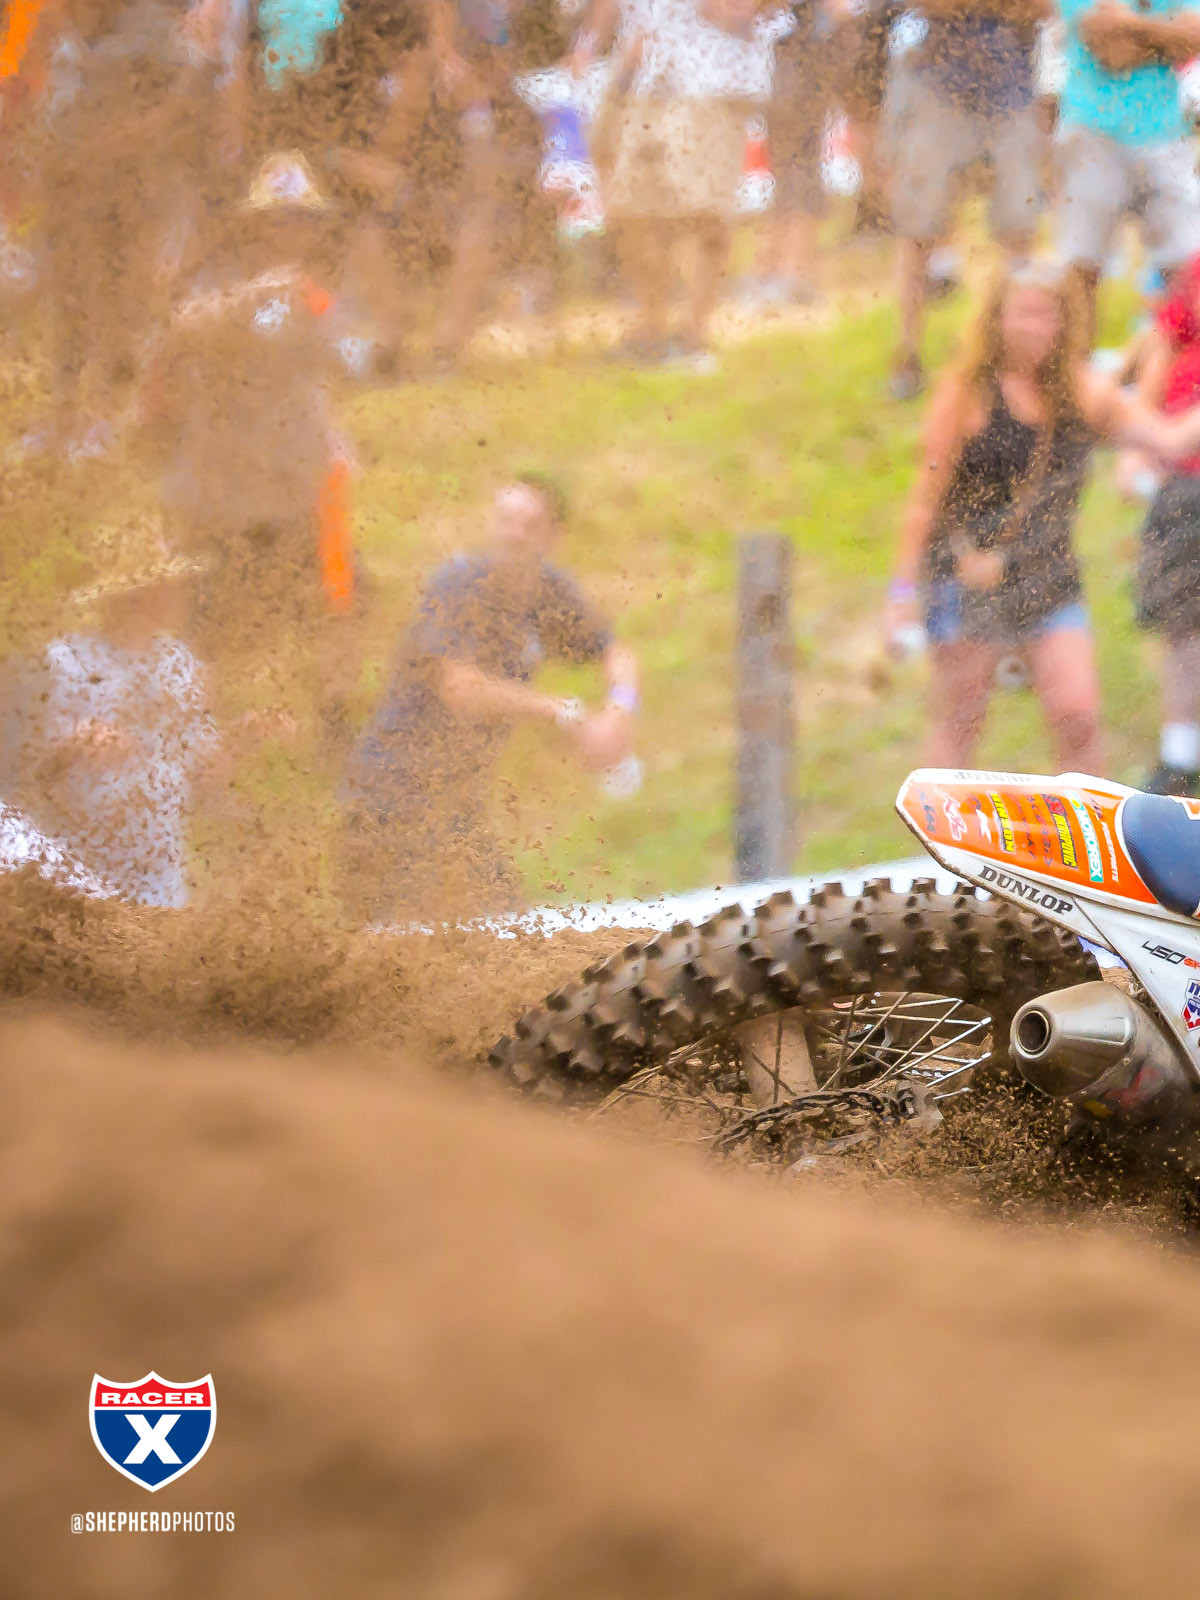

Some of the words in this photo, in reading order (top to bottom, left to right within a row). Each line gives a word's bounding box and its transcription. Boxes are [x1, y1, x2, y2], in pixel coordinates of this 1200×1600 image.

[1074, 807, 1103, 879] MOTOREX
[978, 865, 1074, 915] DUNLOP
[1141, 940, 1187, 965] 450
